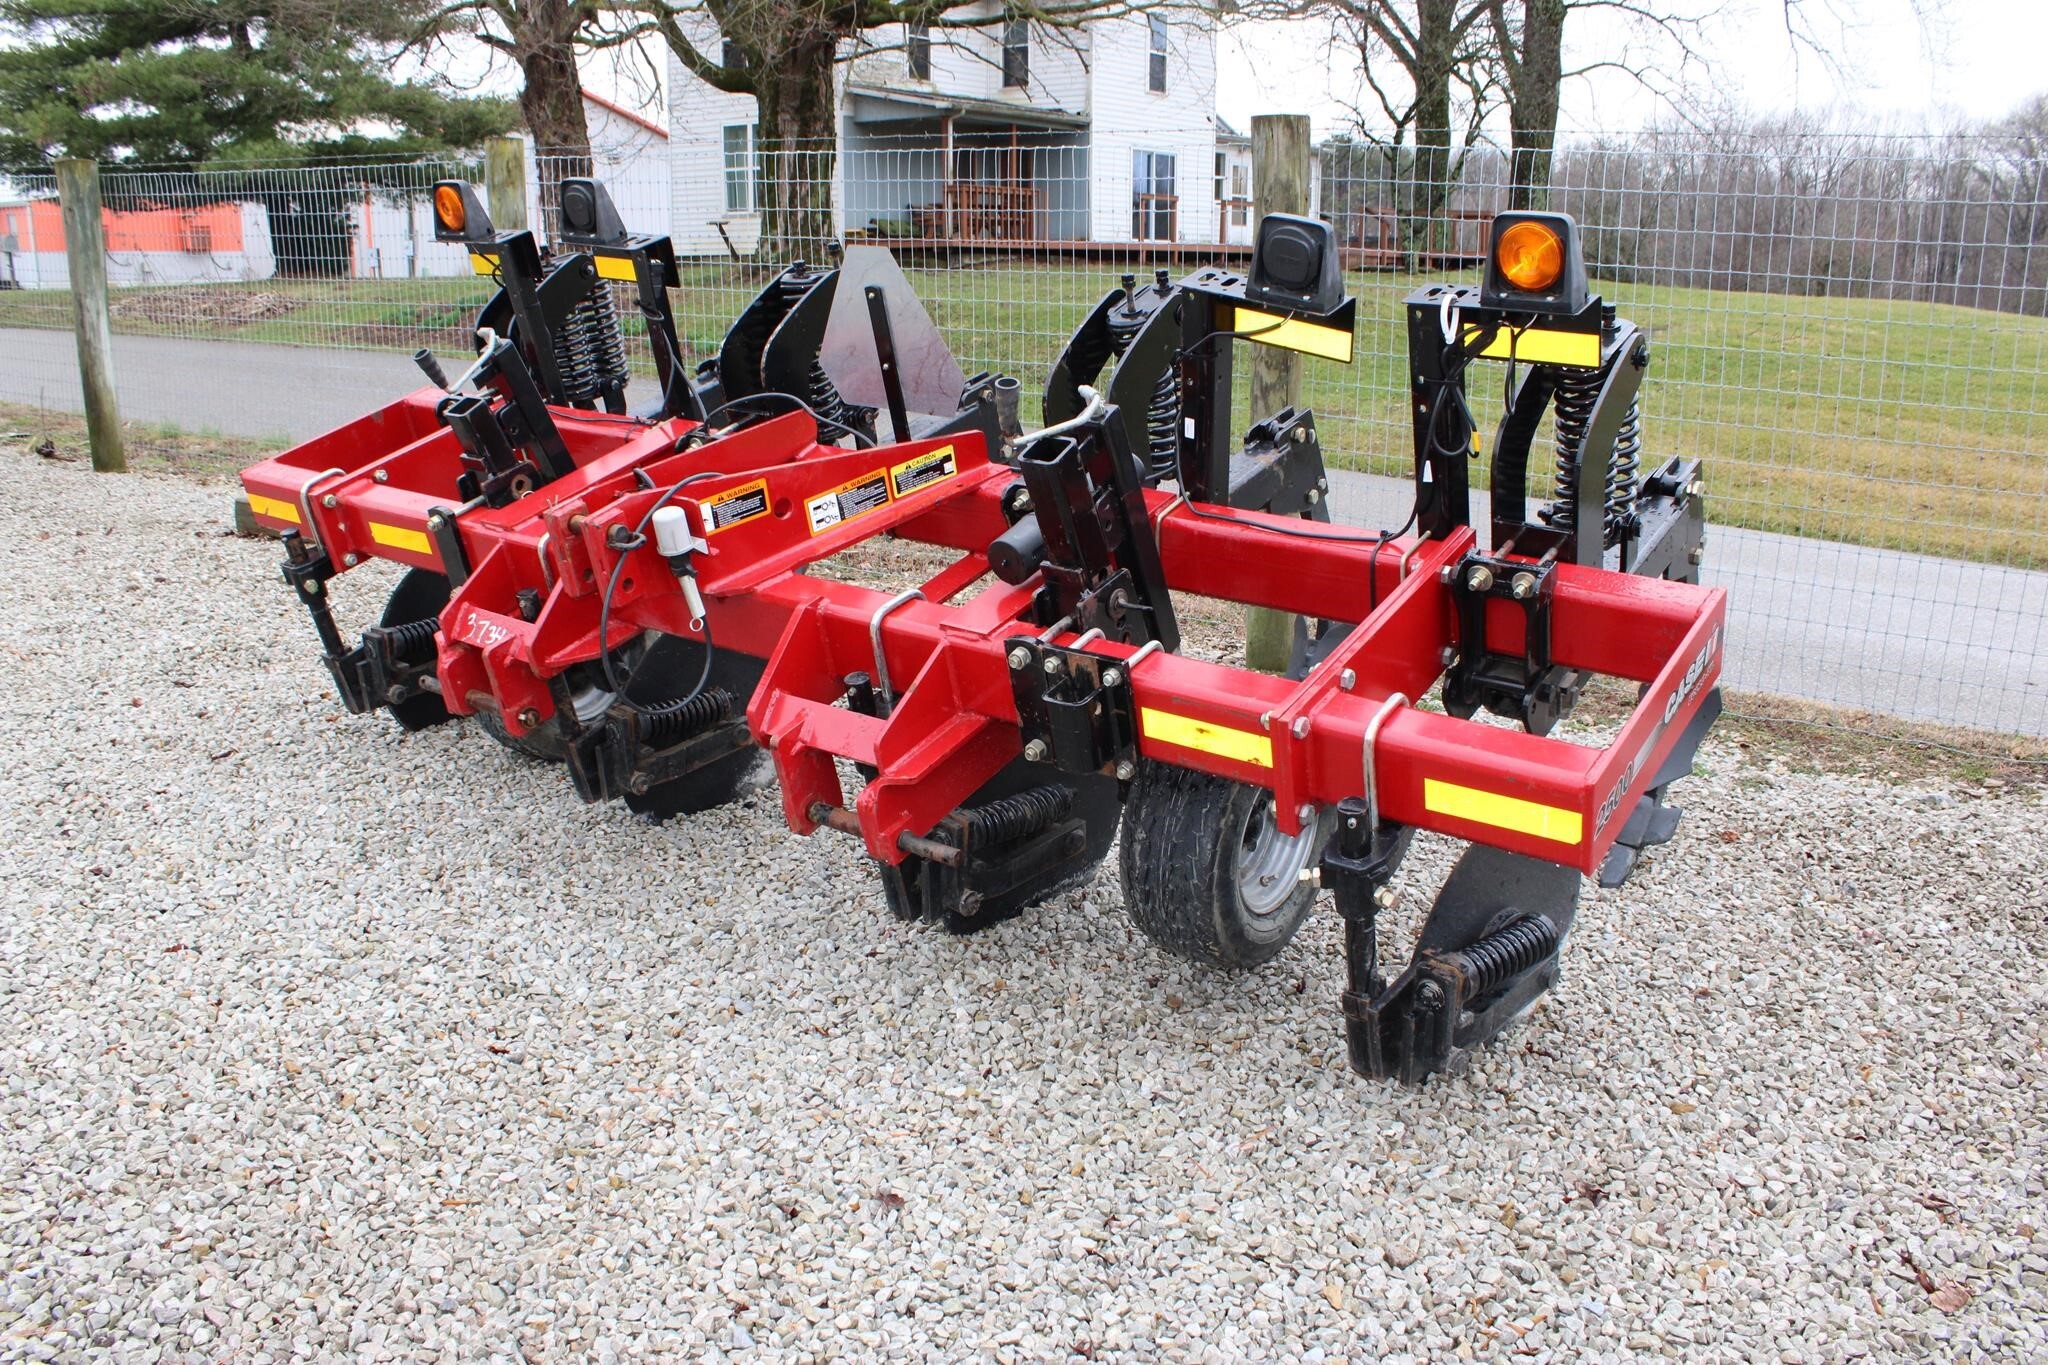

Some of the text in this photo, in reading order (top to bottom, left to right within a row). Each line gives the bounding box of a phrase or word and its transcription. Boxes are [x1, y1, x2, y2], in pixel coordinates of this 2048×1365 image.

[911, 452, 937, 467] CAUTION
[726, 482, 760, 499] WARNING
[850, 471, 882, 488] WARNING
[461, 612, 507, 645] 3734
[1664, 645, 1707, 724] CASE
[1593, 760, 1633, 841] 2500
